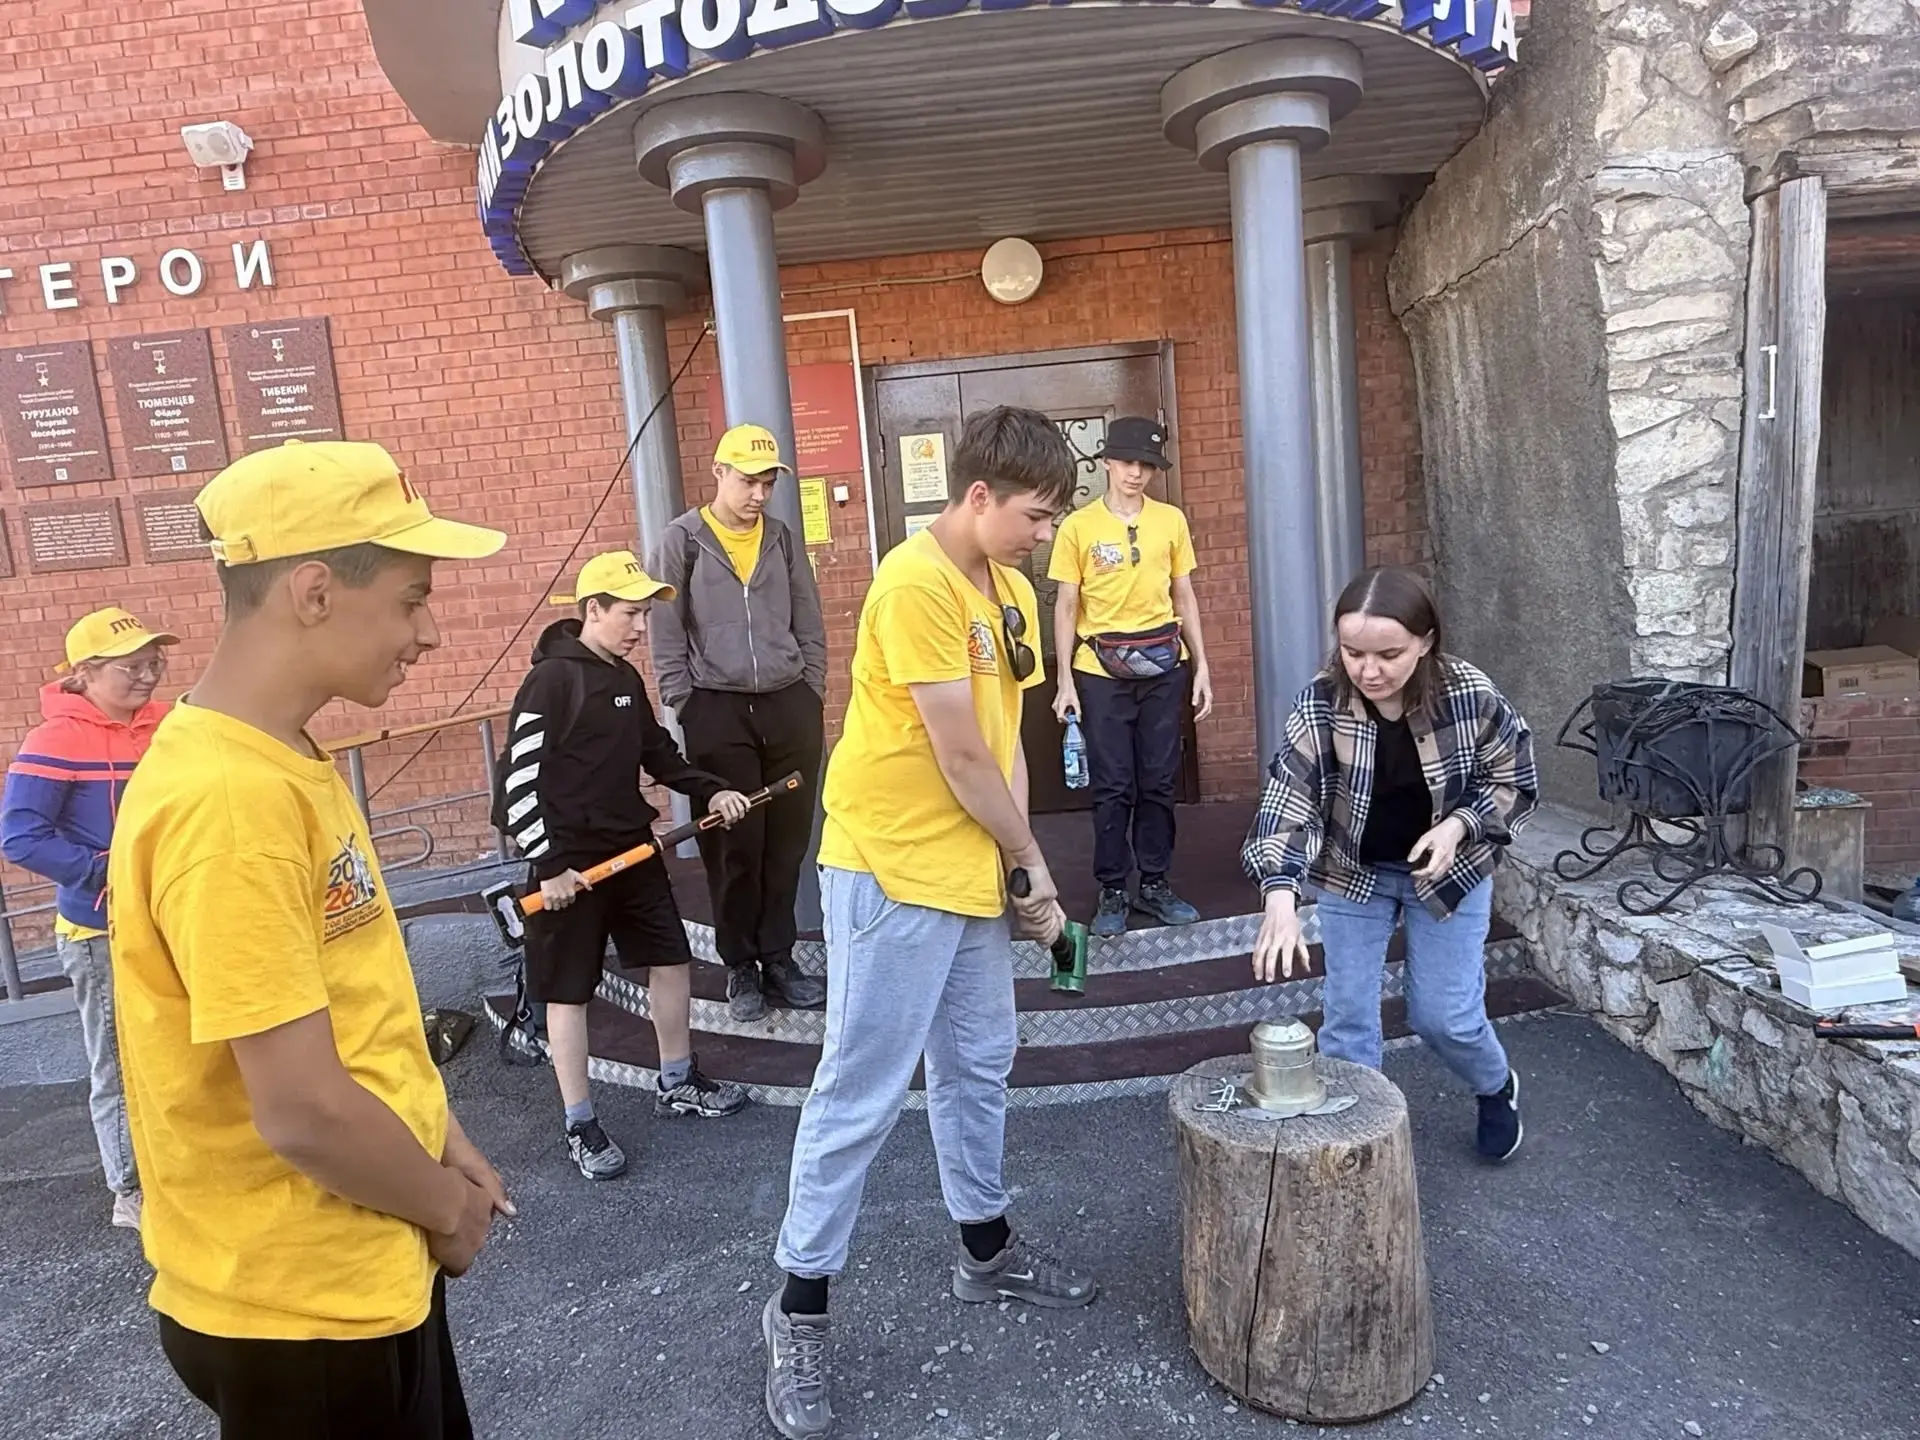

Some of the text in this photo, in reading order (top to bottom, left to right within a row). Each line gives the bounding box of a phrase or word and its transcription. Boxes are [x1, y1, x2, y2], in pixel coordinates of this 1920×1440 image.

[260, 384, 308, 397] ТИБЕКИН
[137, 395, 195, 409] ТЮМЕНЦЕВ
[276, 397, 296, 405] Олег
[20, 406, 80, 420] ТУРУХАНОВ
[751, 440, 775, 451] ЛТО
[614, 695, 632, 707] OFF
[328, 859, 354, 888] 20
[325, 883, 356, 912] 26
